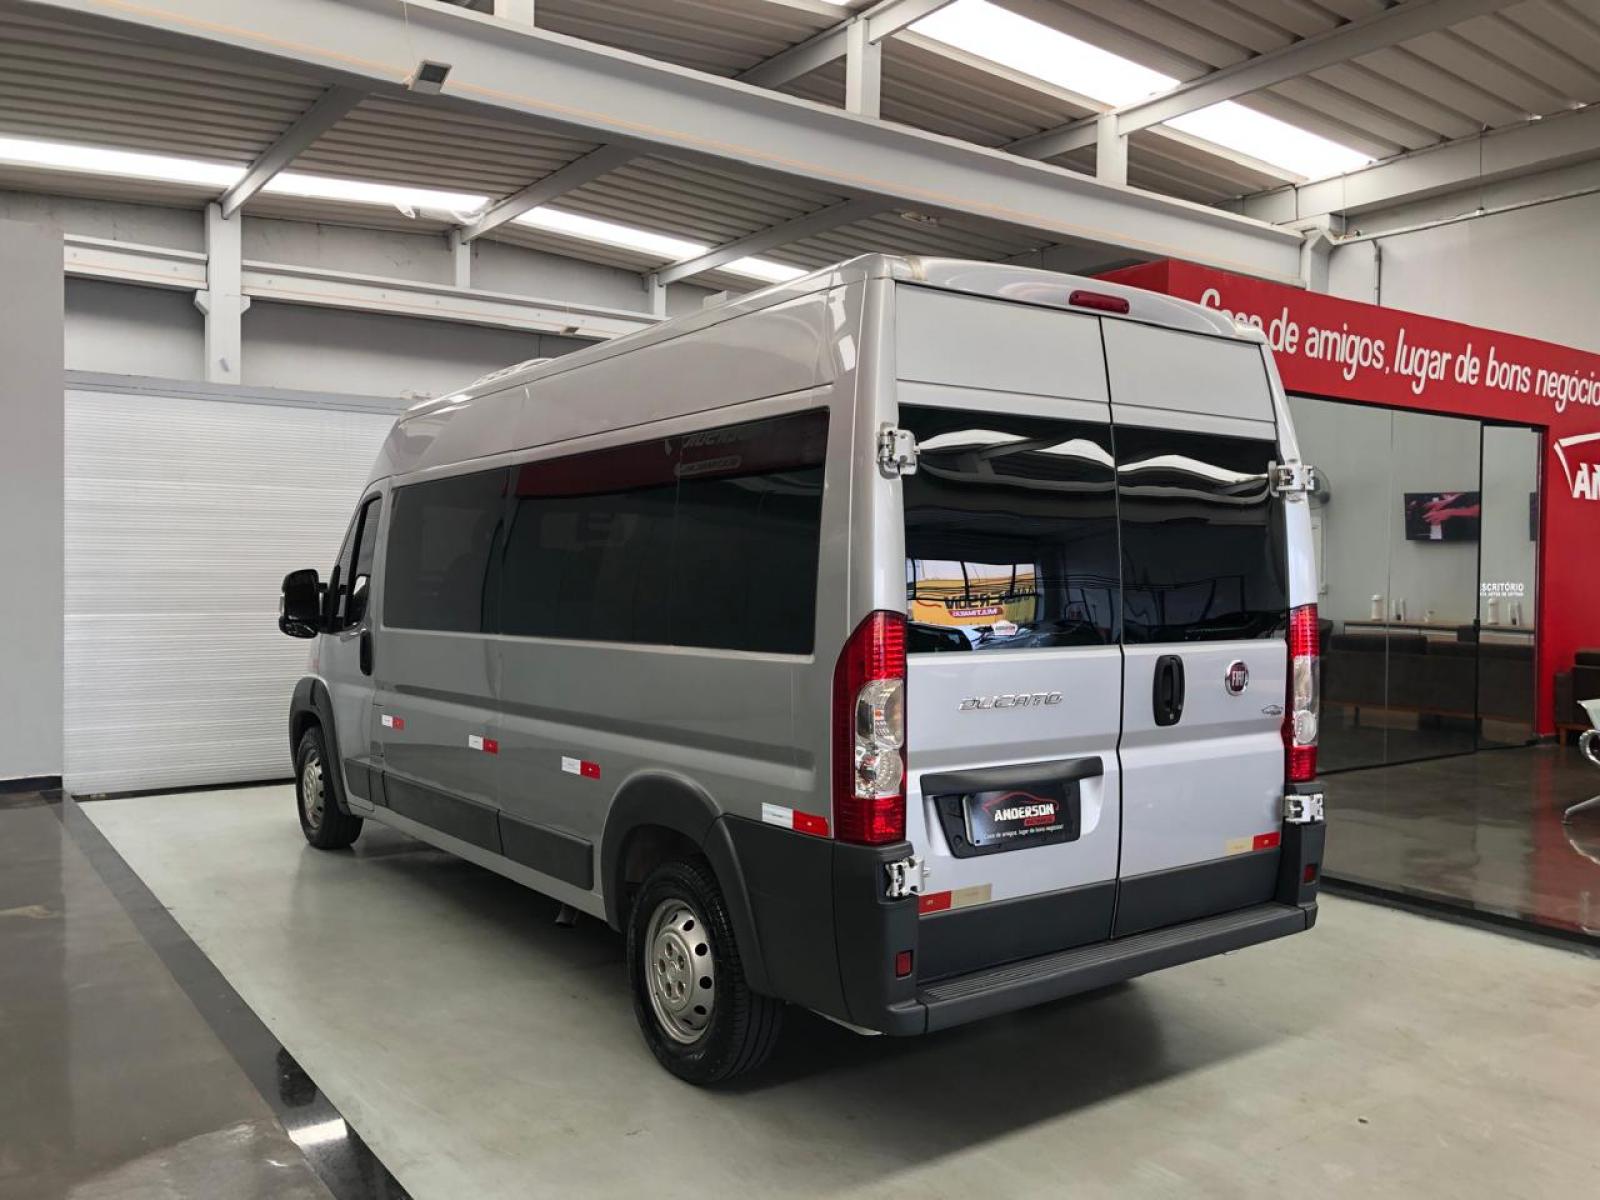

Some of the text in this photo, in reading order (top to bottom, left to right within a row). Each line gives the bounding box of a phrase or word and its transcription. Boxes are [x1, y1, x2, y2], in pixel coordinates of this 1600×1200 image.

[1269, 306, 1299, 354] de
[1305, 323, 1390, 380] amigos,
[1394, 328, 1451, 394] lugar
[1455, 343, 1480, 385] de
[1485, 346, 1531, 393] bons
[959, 692, 1063, 710] DUCATO
[994, 803, 1055, 822] ANDERSON
